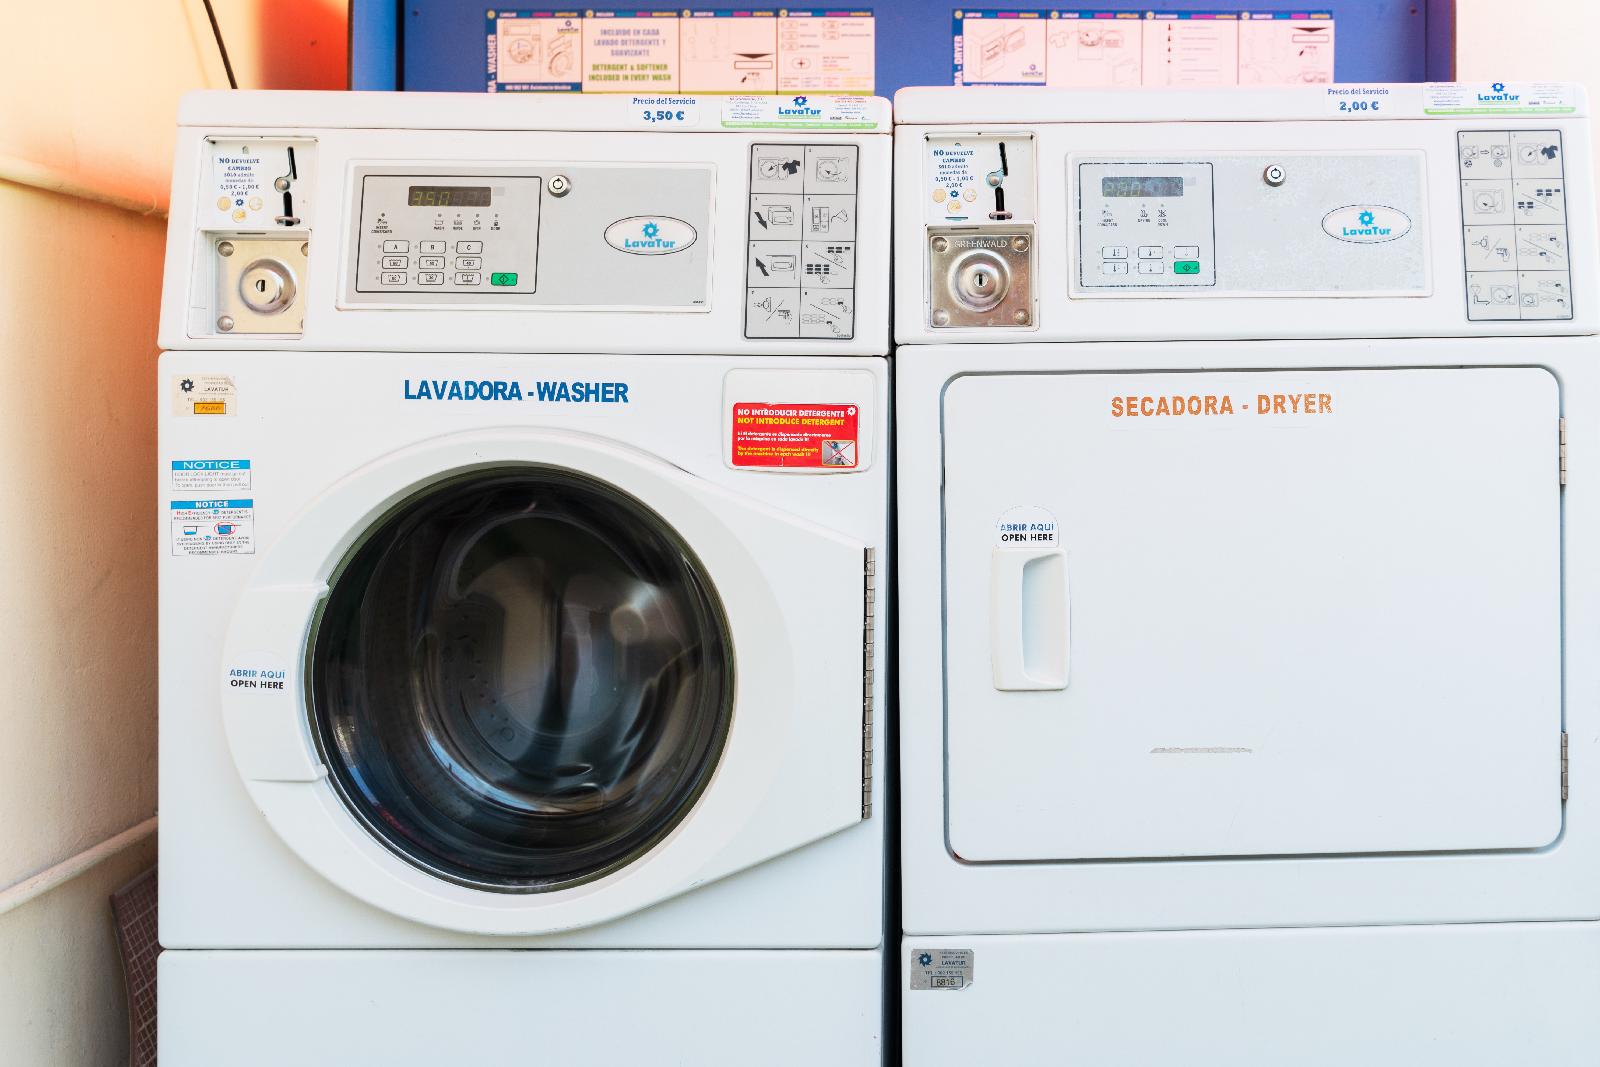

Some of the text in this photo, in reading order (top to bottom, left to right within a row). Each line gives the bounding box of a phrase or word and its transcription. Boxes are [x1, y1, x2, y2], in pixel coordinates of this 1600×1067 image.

[487, 34, 497, 74] WASHER
[954, 35, 963, 64] DRYER
[632, 97, 696, 105] Precio del Servicio
[778, 107, 822, 115] LavaTur
[1340, 101, 1379, 112] 2,00 €
[643, 110, 685, 122] 3,50 €
[1342, 226, 1391, 236] LavaTur
[624, 238, 676, 248] LavaTur
[954, 240, 1008, 248] GREENWALD
[404, 380, 522, 401] LAVADORA
[536, 382, 628, 403] WASHER
[1111, 395, 1234, 417] SECADORA
[1257, 393, 1332, 414] DRYER
[183, 461, 240, 469] NOTICE
[1001, 534, 1027, 542] OPEN
[230, 669, 257, 677] ABRIR
[231, 680, 284, 690] OPEN HERE
